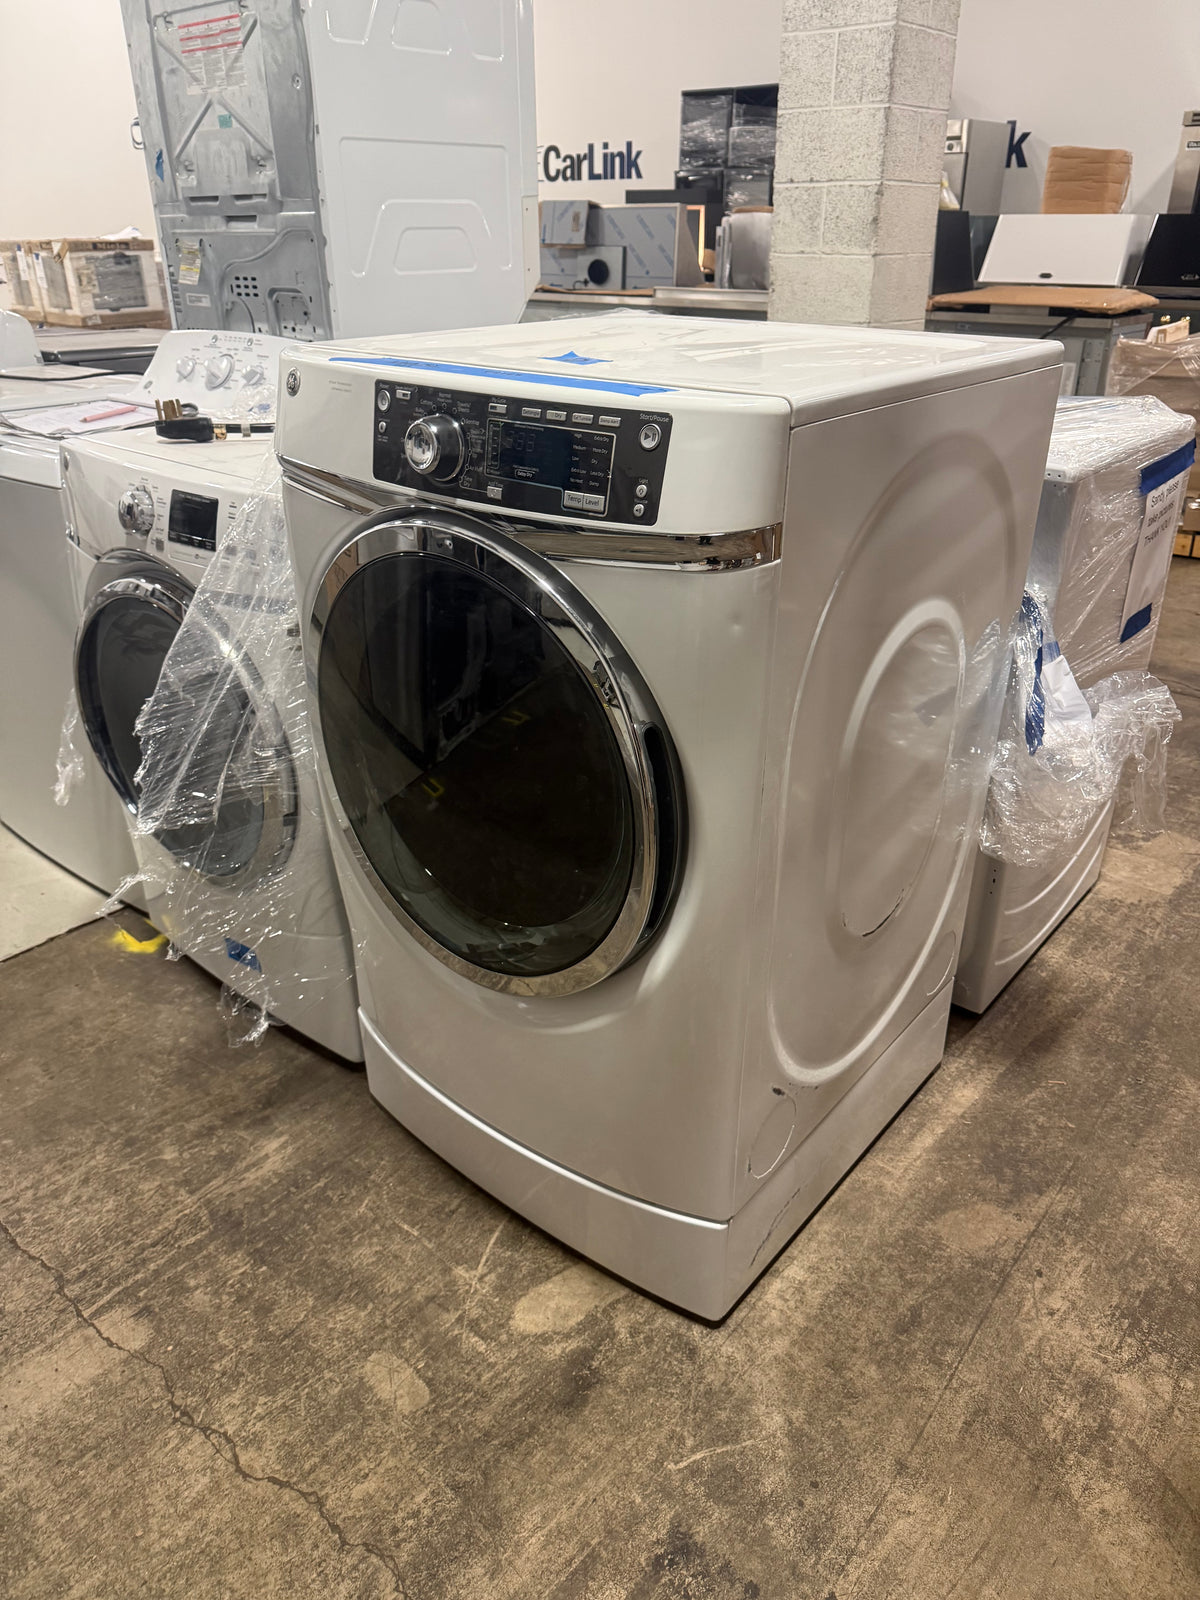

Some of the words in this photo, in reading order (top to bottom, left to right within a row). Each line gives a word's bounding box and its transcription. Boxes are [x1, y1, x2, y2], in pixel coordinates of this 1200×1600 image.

[543, 141, 643, 182] CarLink
[640, 413, 669, 422] Start/Pause
[567, 494, 582, 504] Temp
[585, 497, 600, 507] Level
